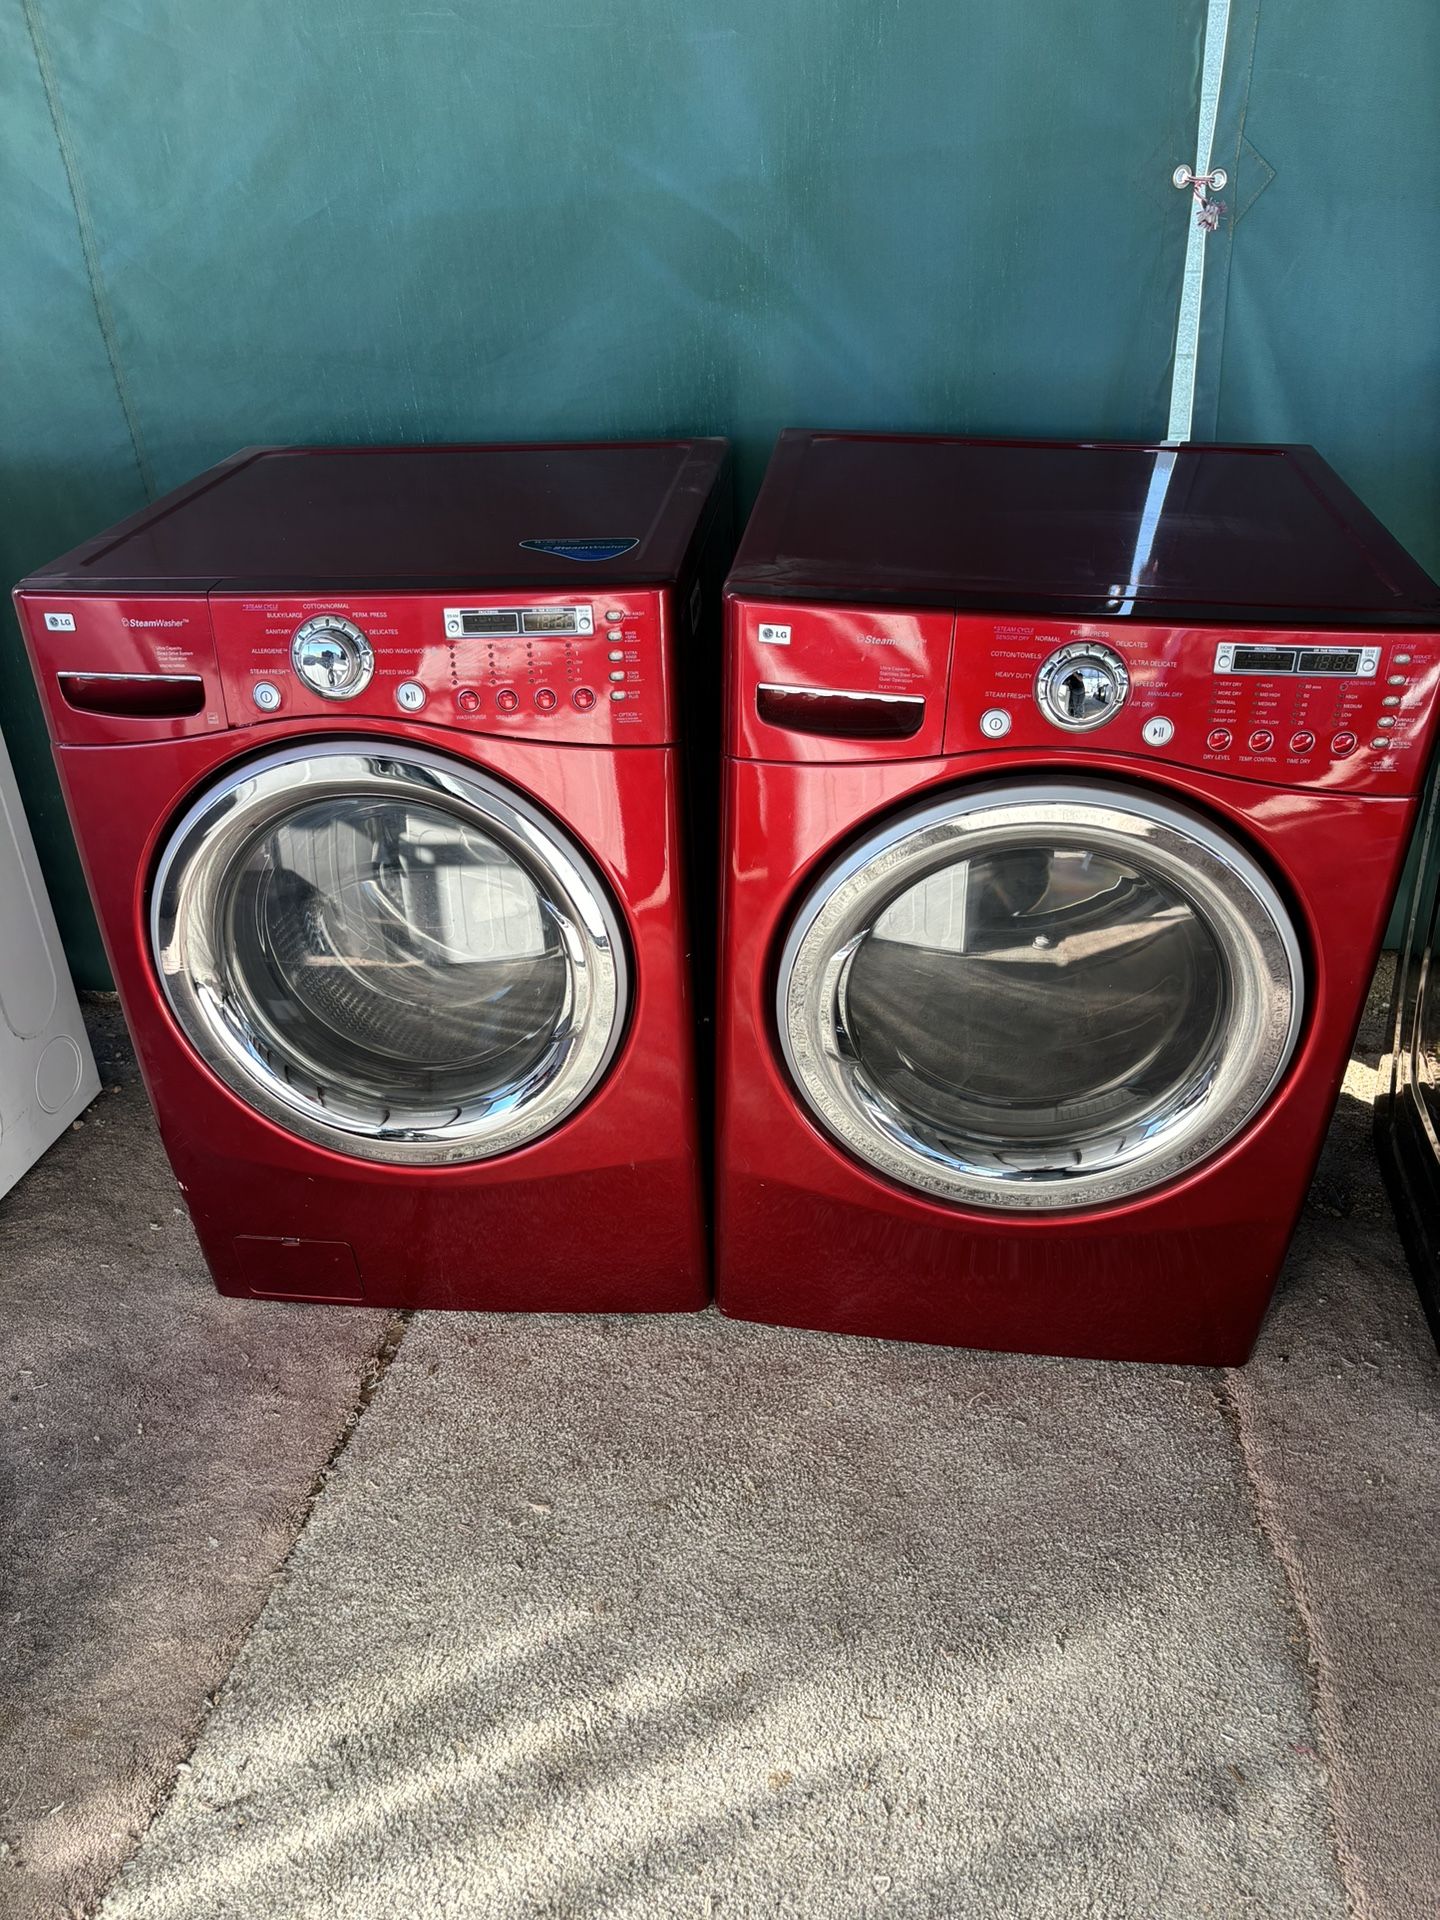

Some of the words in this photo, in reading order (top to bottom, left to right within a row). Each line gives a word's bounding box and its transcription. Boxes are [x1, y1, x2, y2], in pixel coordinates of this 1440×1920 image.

[1034, 635, 1061, 643] NORMAL
[1115, 640, 1149, 648] DELICATES
[990, 650, 1042, 659] COTTON/TOWELS
[1130, 659, 1149, 667] ULTRA
[1150, 661, 1178, 669] DELICATE
[985, 690, 1006, 698] STEAM
[1130, 700, 1141, 708] AIR
[1141, 701, 1155, 709] DRY
[1203, 753, 1215, 761] DRY
